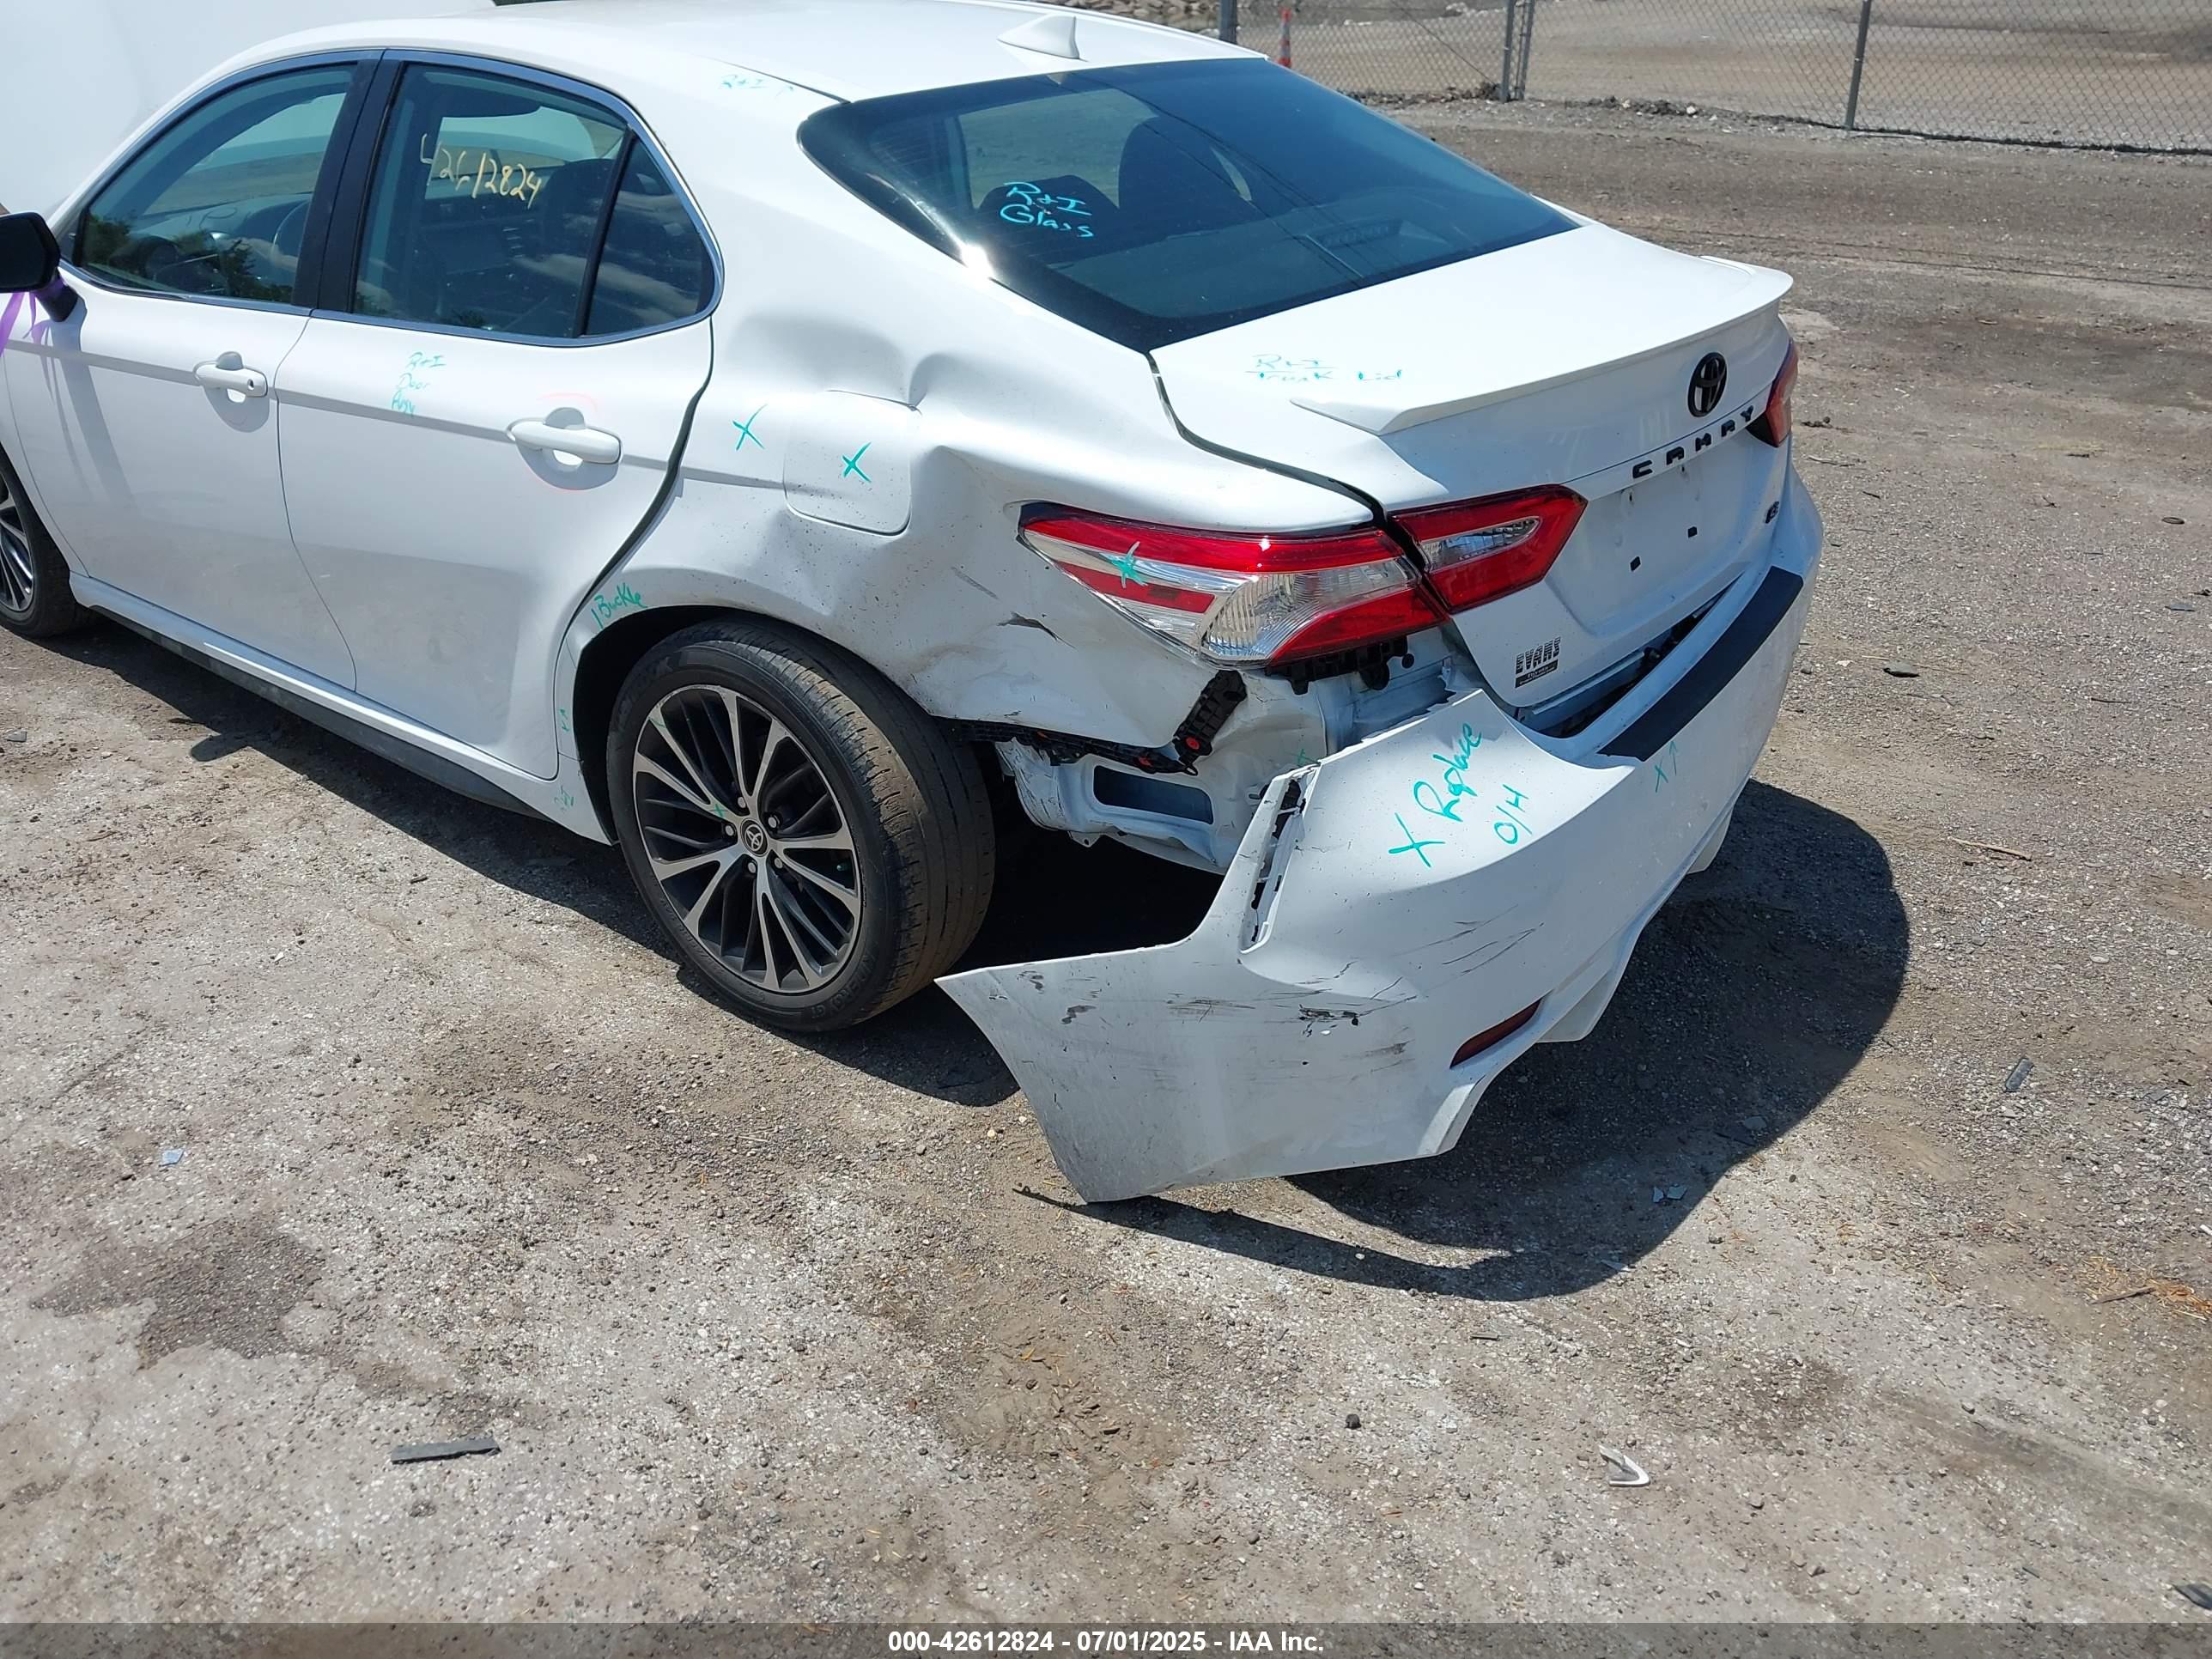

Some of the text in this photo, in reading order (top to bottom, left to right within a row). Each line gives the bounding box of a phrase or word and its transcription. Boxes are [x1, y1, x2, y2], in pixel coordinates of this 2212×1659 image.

[1000, 204, 1094, 238] Glass
[1632, 404, 1754, 479] CAMRY
[1515, 635, 1561, 674] EVANS
